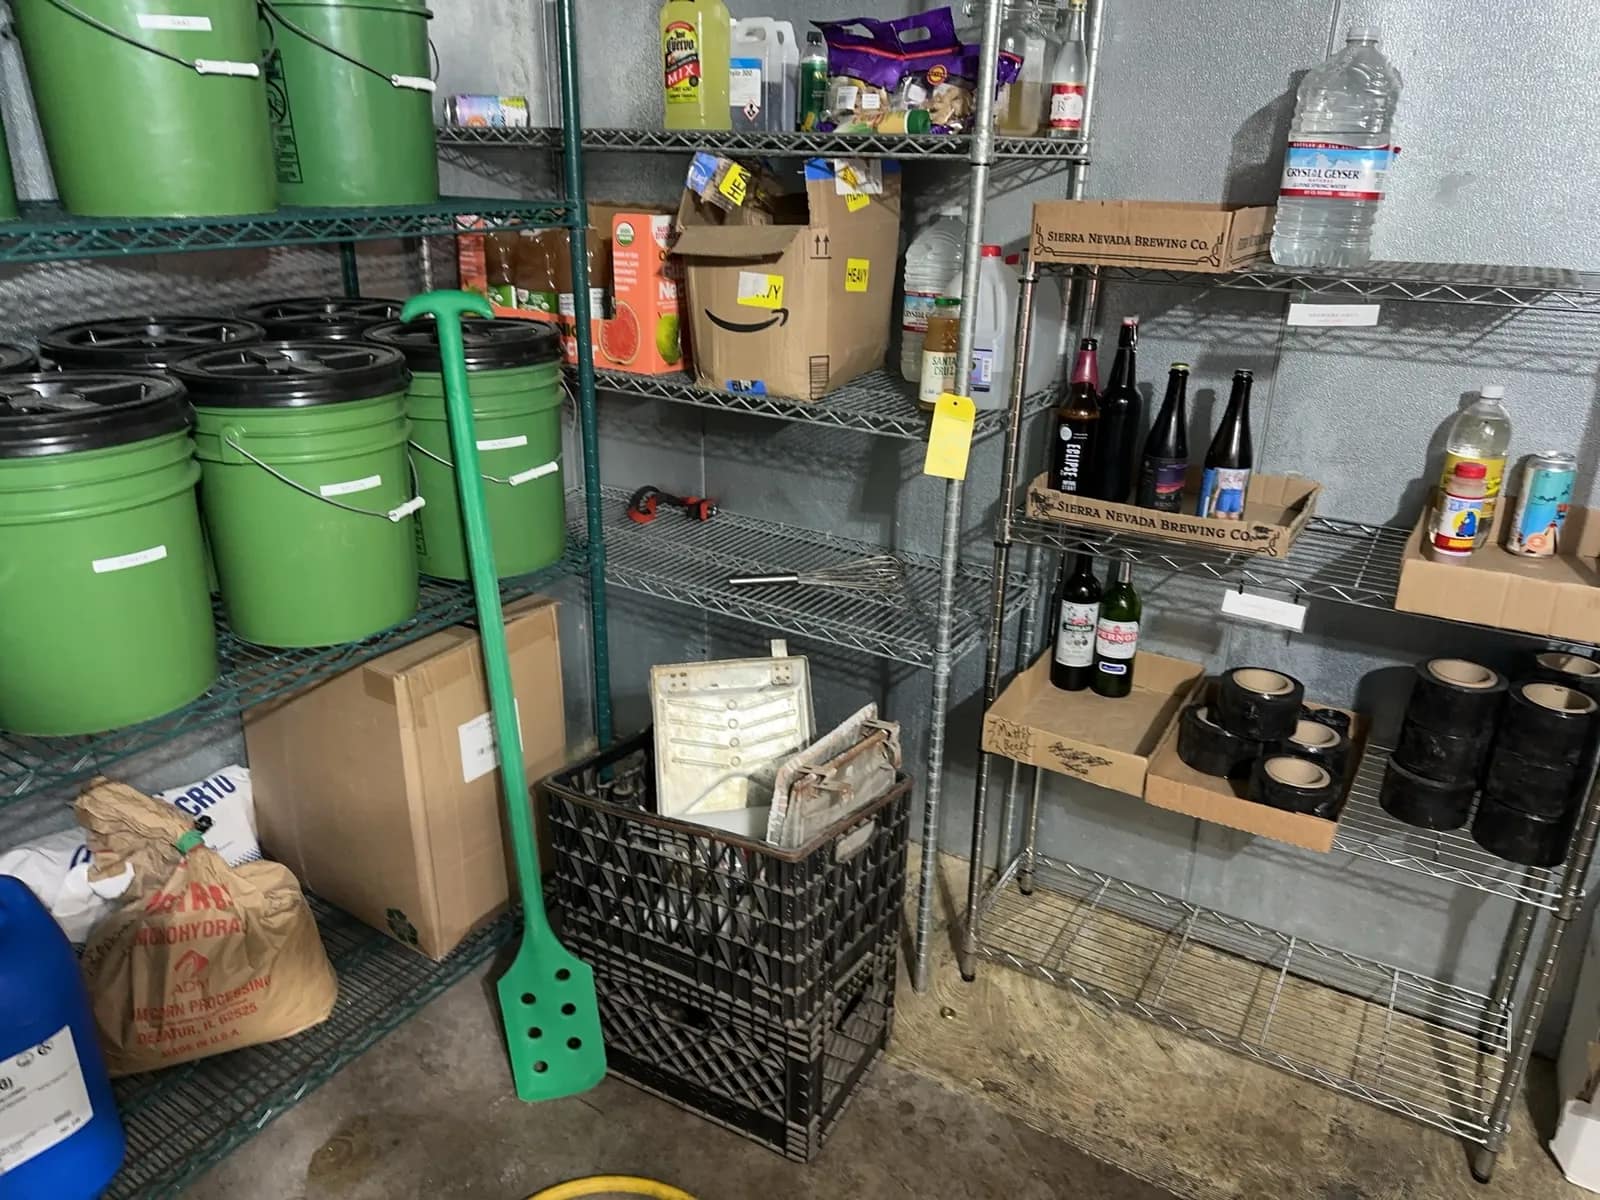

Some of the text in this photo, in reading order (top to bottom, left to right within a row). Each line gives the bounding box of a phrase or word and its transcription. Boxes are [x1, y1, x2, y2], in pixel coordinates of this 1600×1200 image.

[667, 63, 695, 86] MIX
[1287, 167, 1360, 180] CRYSTAL GEYSER
[1047, 231, 1209, 250] SIERRA NEVADA BREWING CO.
[1064, 444, 1081, 477] ECLIPSE
[1057, 501, 1100, 518] SIERRA
[1106, 509, 1156, 528] NEVADA
[1161, 520, 1225, 538] BREWING
